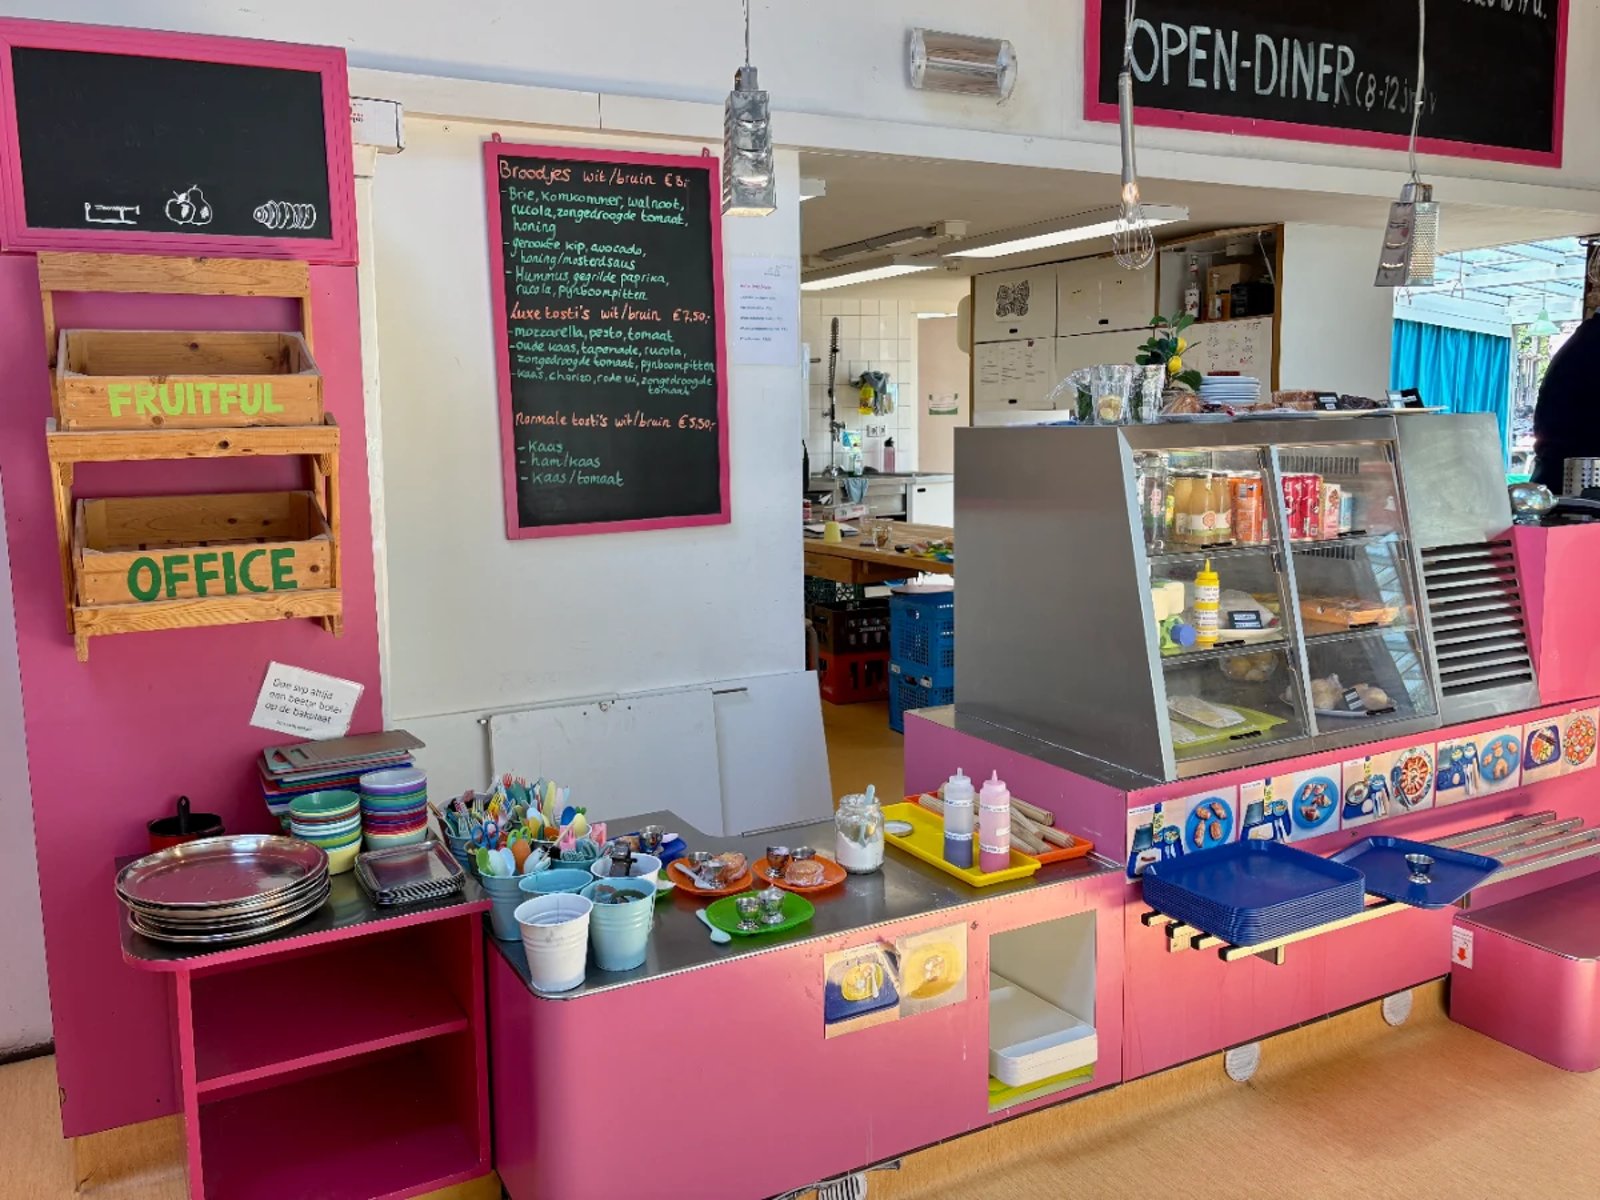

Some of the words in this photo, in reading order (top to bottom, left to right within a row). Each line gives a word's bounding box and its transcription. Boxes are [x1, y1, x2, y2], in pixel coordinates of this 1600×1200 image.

[1129, 18, 1356, 106] OPEN-DINER
[500, 160, 572, 185] Broodjes
[513, 217, 556, 239] honing
[545, 305, 590, 321] tosti's
[107, 382, 285, 417] FRUITFUL
[127, 547, 298, 602] OFFICE
